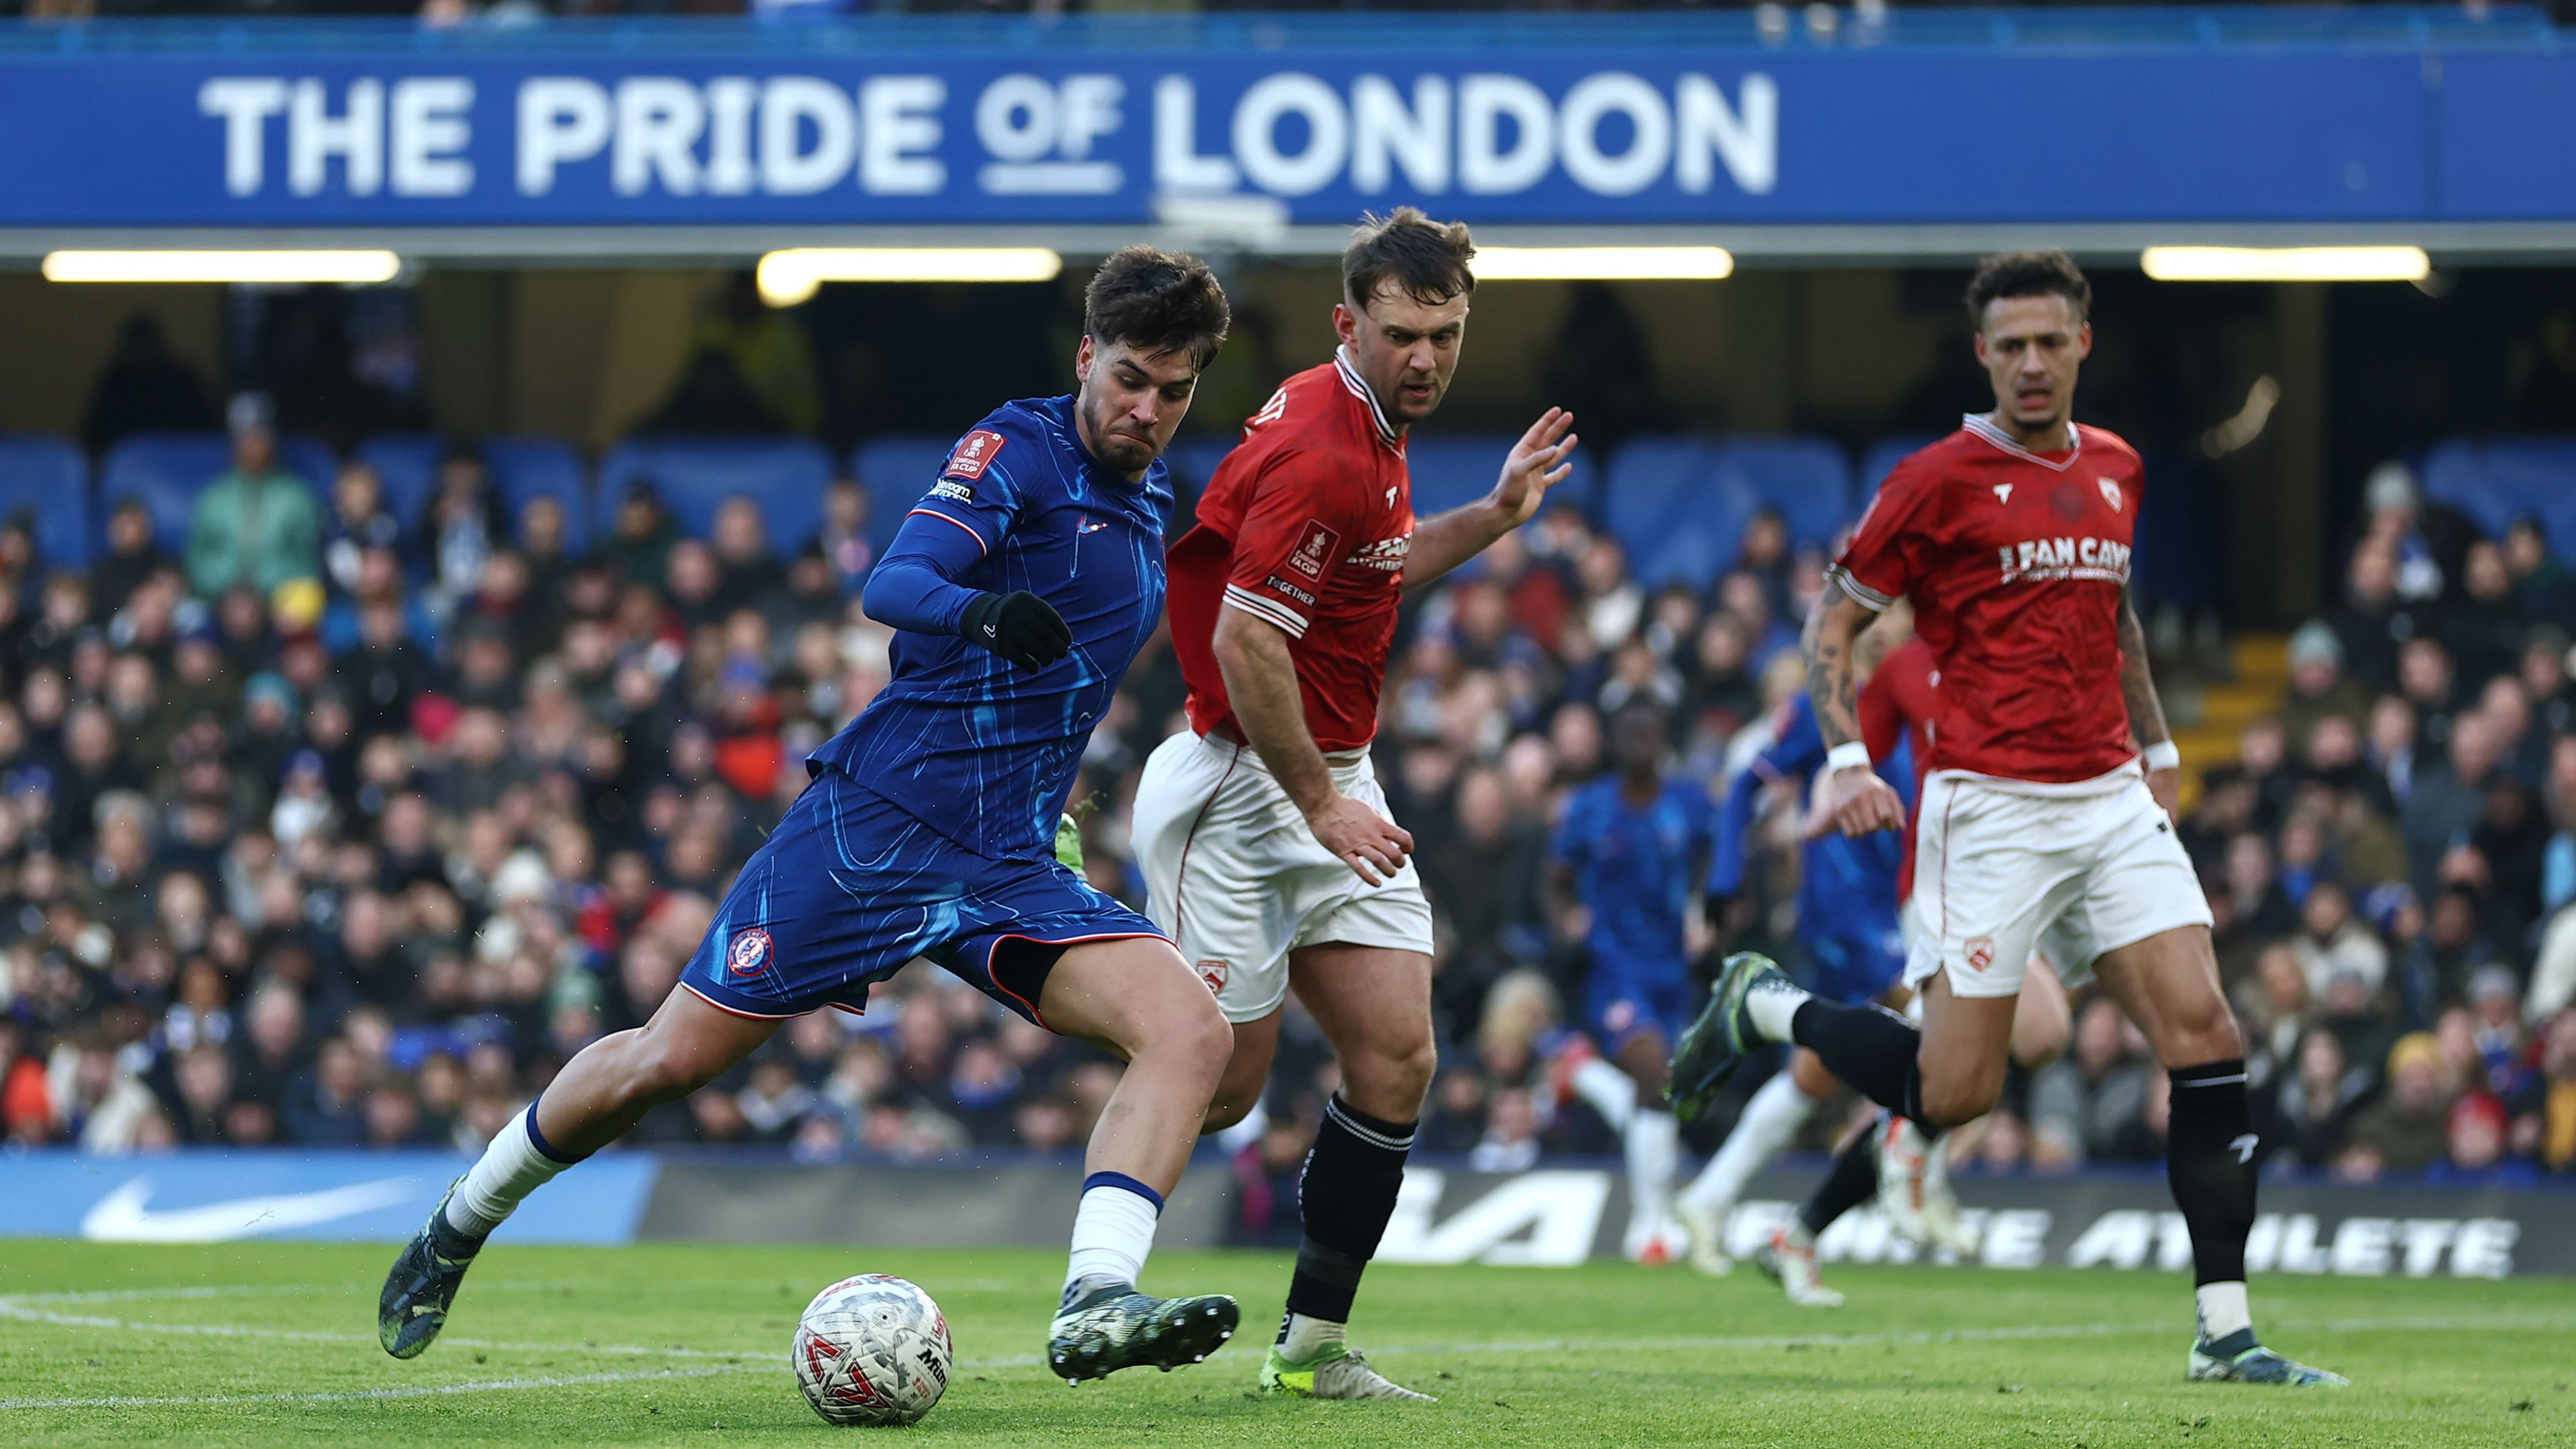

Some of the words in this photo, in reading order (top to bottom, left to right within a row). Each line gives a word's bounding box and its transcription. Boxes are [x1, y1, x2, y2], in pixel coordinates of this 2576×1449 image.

[198, 77, 475, 196] THE
[516, 77, 945, 196] PRIDE
[976, 74, 1123, 161] OF
[1155, 73, 1778, 195] LONDON
[959, 464, 978, 472] CUP
[937, 478, 946, 489] No
[945, 482, 970, 498] room
[1291, 557, 1301, 568] FA
[1301, 562, 1318, 575] CUP
[2018, 537, 2075, 571] FAN
[1267, 576, 1315, 607] TOGETHER
